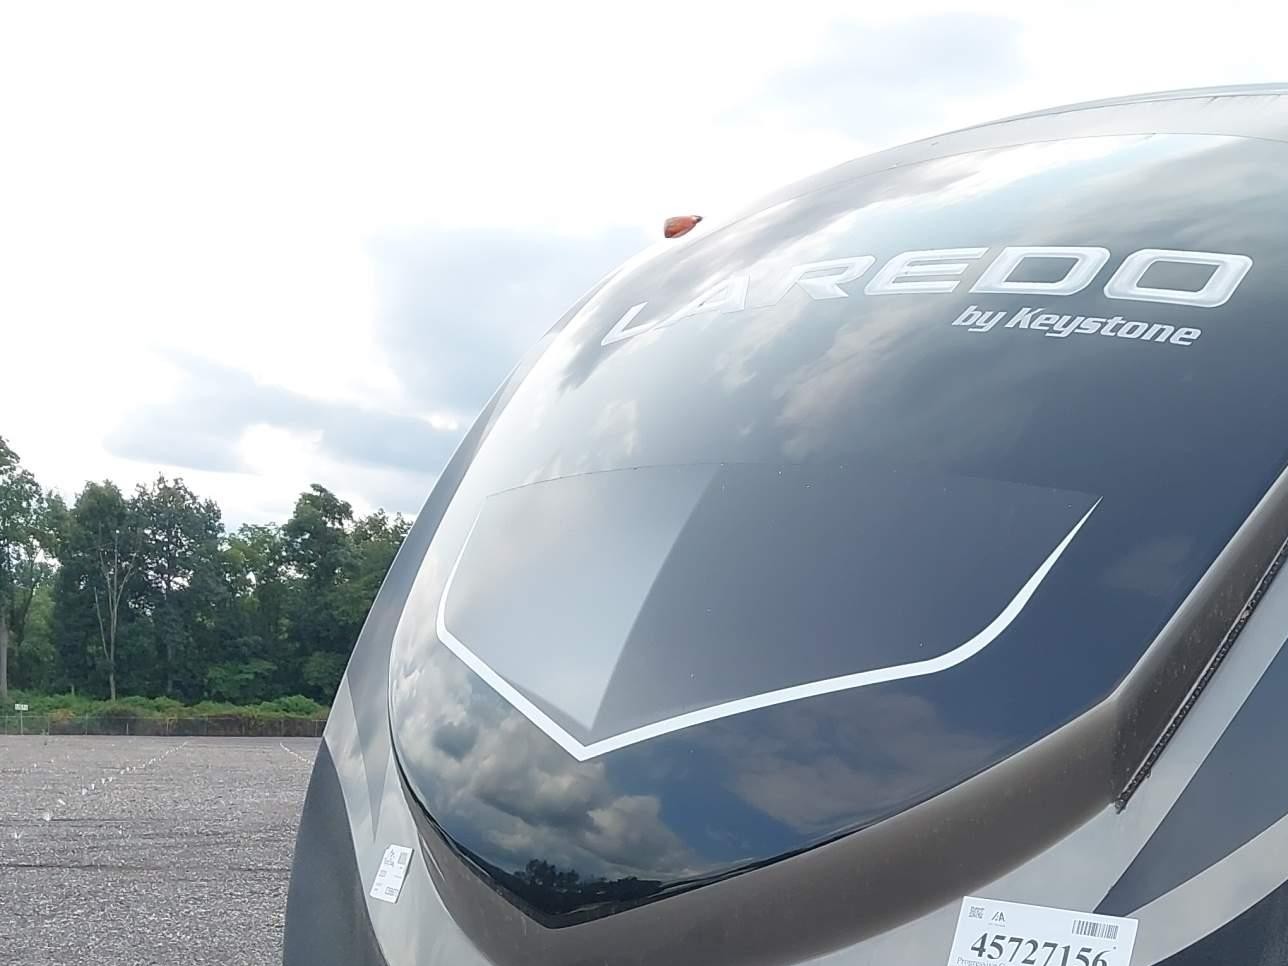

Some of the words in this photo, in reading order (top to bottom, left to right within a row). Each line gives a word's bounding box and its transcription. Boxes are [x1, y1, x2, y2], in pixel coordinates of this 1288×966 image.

[601, 246, 1253, 346] LAREDO
[952, 305, 995, 335] by
[1003, 306, 1202, 346] Keystone
